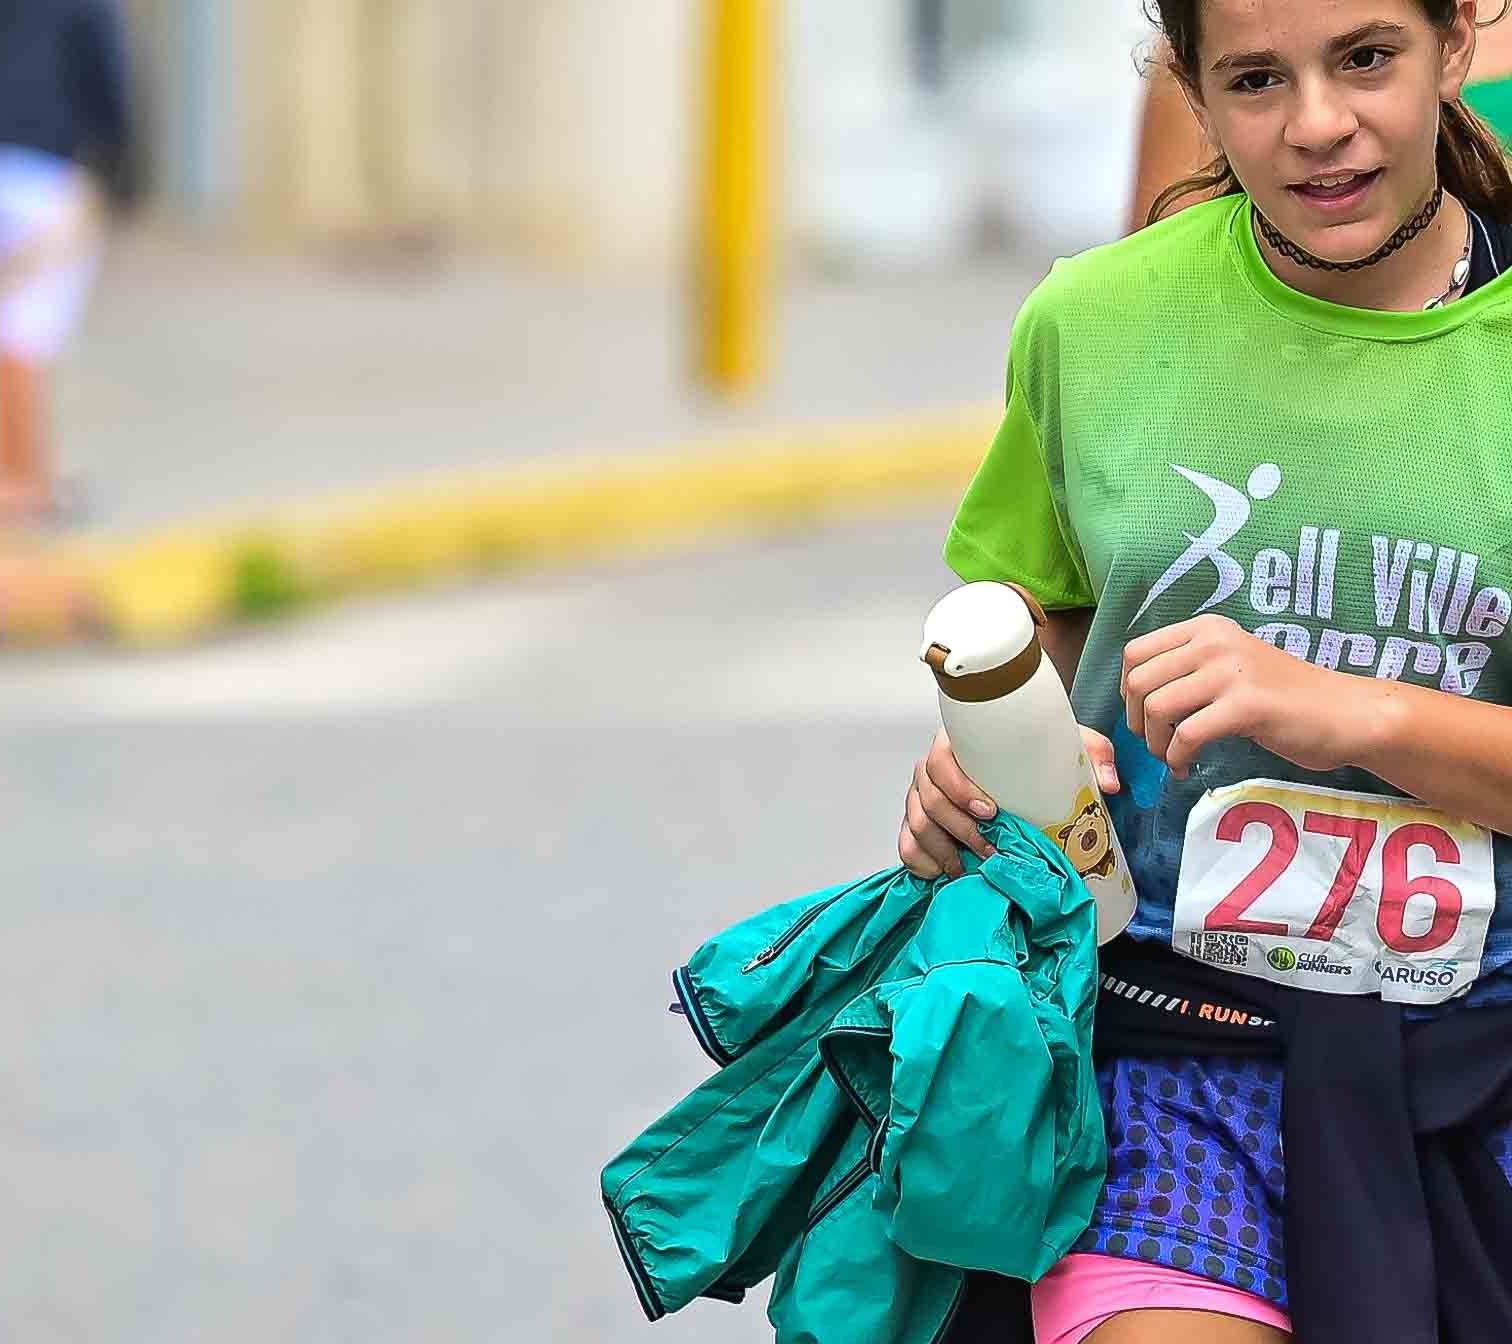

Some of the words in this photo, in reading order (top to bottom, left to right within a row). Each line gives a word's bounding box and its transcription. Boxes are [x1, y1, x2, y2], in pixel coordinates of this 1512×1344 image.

[1371, 534, 1512, 637] Ville
[1203, 801, 1463, 953] 276
[1298, 952, 1328, 964] CLUB
